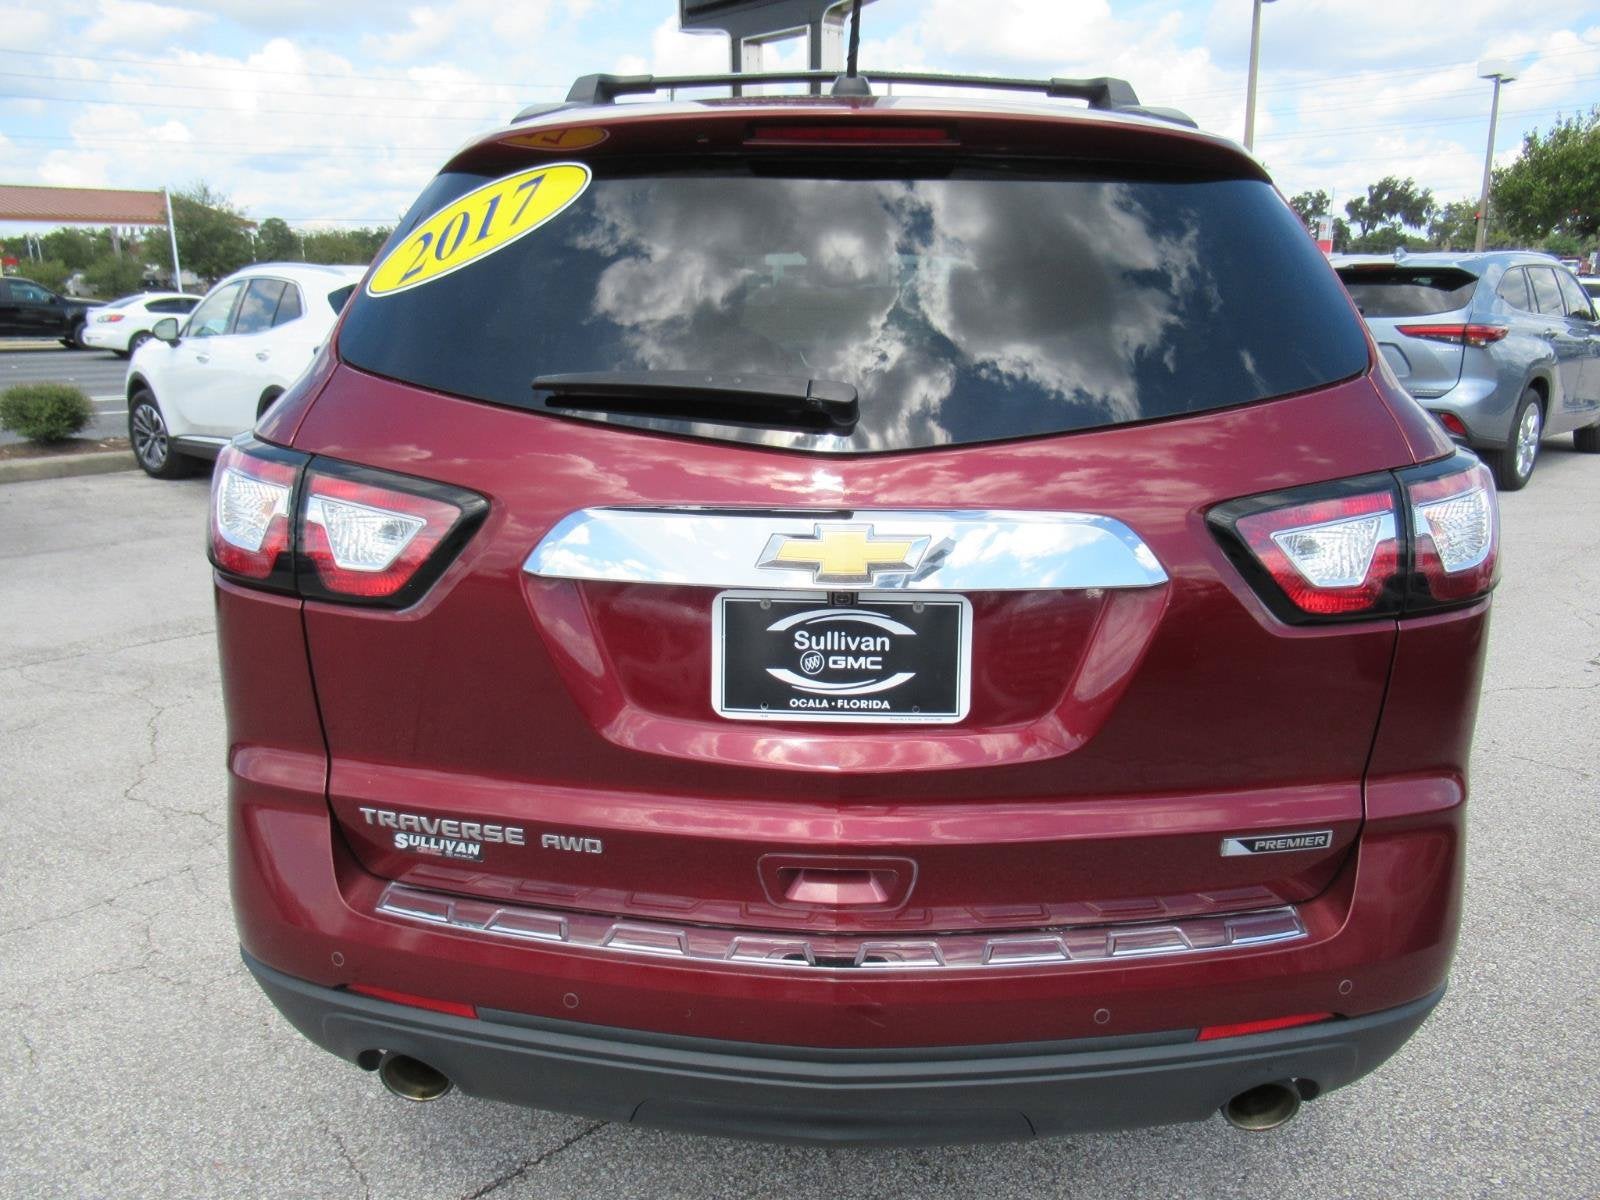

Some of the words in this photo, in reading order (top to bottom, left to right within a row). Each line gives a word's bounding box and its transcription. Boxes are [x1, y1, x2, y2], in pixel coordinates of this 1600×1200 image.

[397, 173, 548, 285] 2017
[794, 630, 890, 652] Sullivan
[828, 655, 883, 670] GMC
[789, 698, 829, 709] OCALA
[837, 699, 891, 710] FLORIDA
[359, 807, 526, 846] TRAVERSE
[541, 834, 603, 854] AWD
[394, 832, 481, 856] SULLIVAN
[1254, 835, 1326, 851] PREMIER
